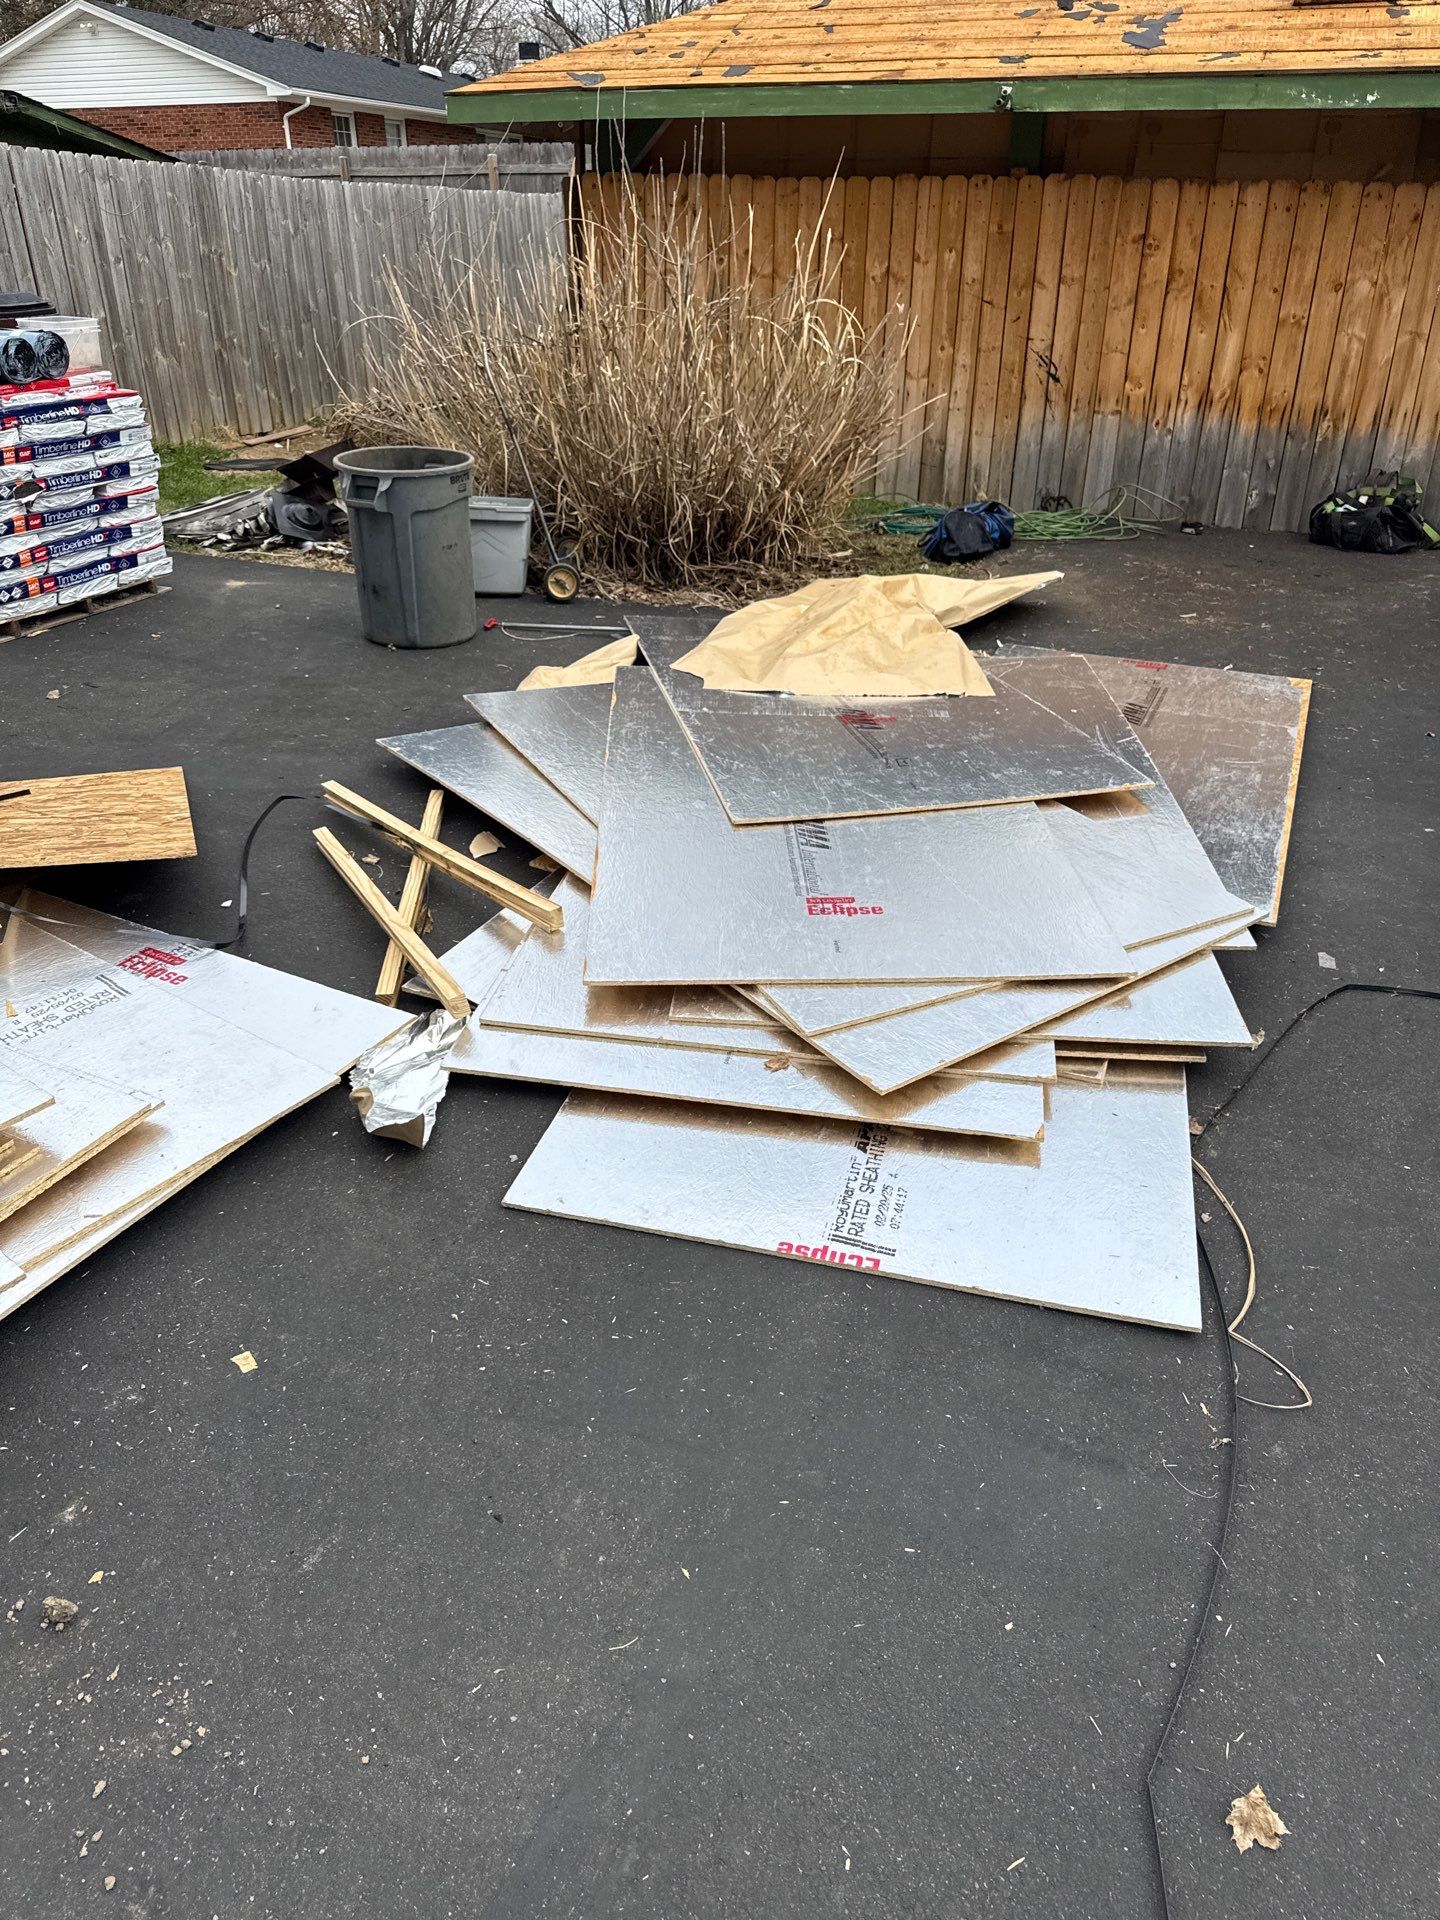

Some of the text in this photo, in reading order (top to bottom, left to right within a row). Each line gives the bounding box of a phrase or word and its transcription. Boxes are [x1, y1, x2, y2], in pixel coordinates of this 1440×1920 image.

[806, 904, 884, 917] Eclipse
[117, 954, 189, 985] Eclipse
[64, 989, 111, 1013] RATED
[847, 1134, 888, 1237] RATED SHEATHING
